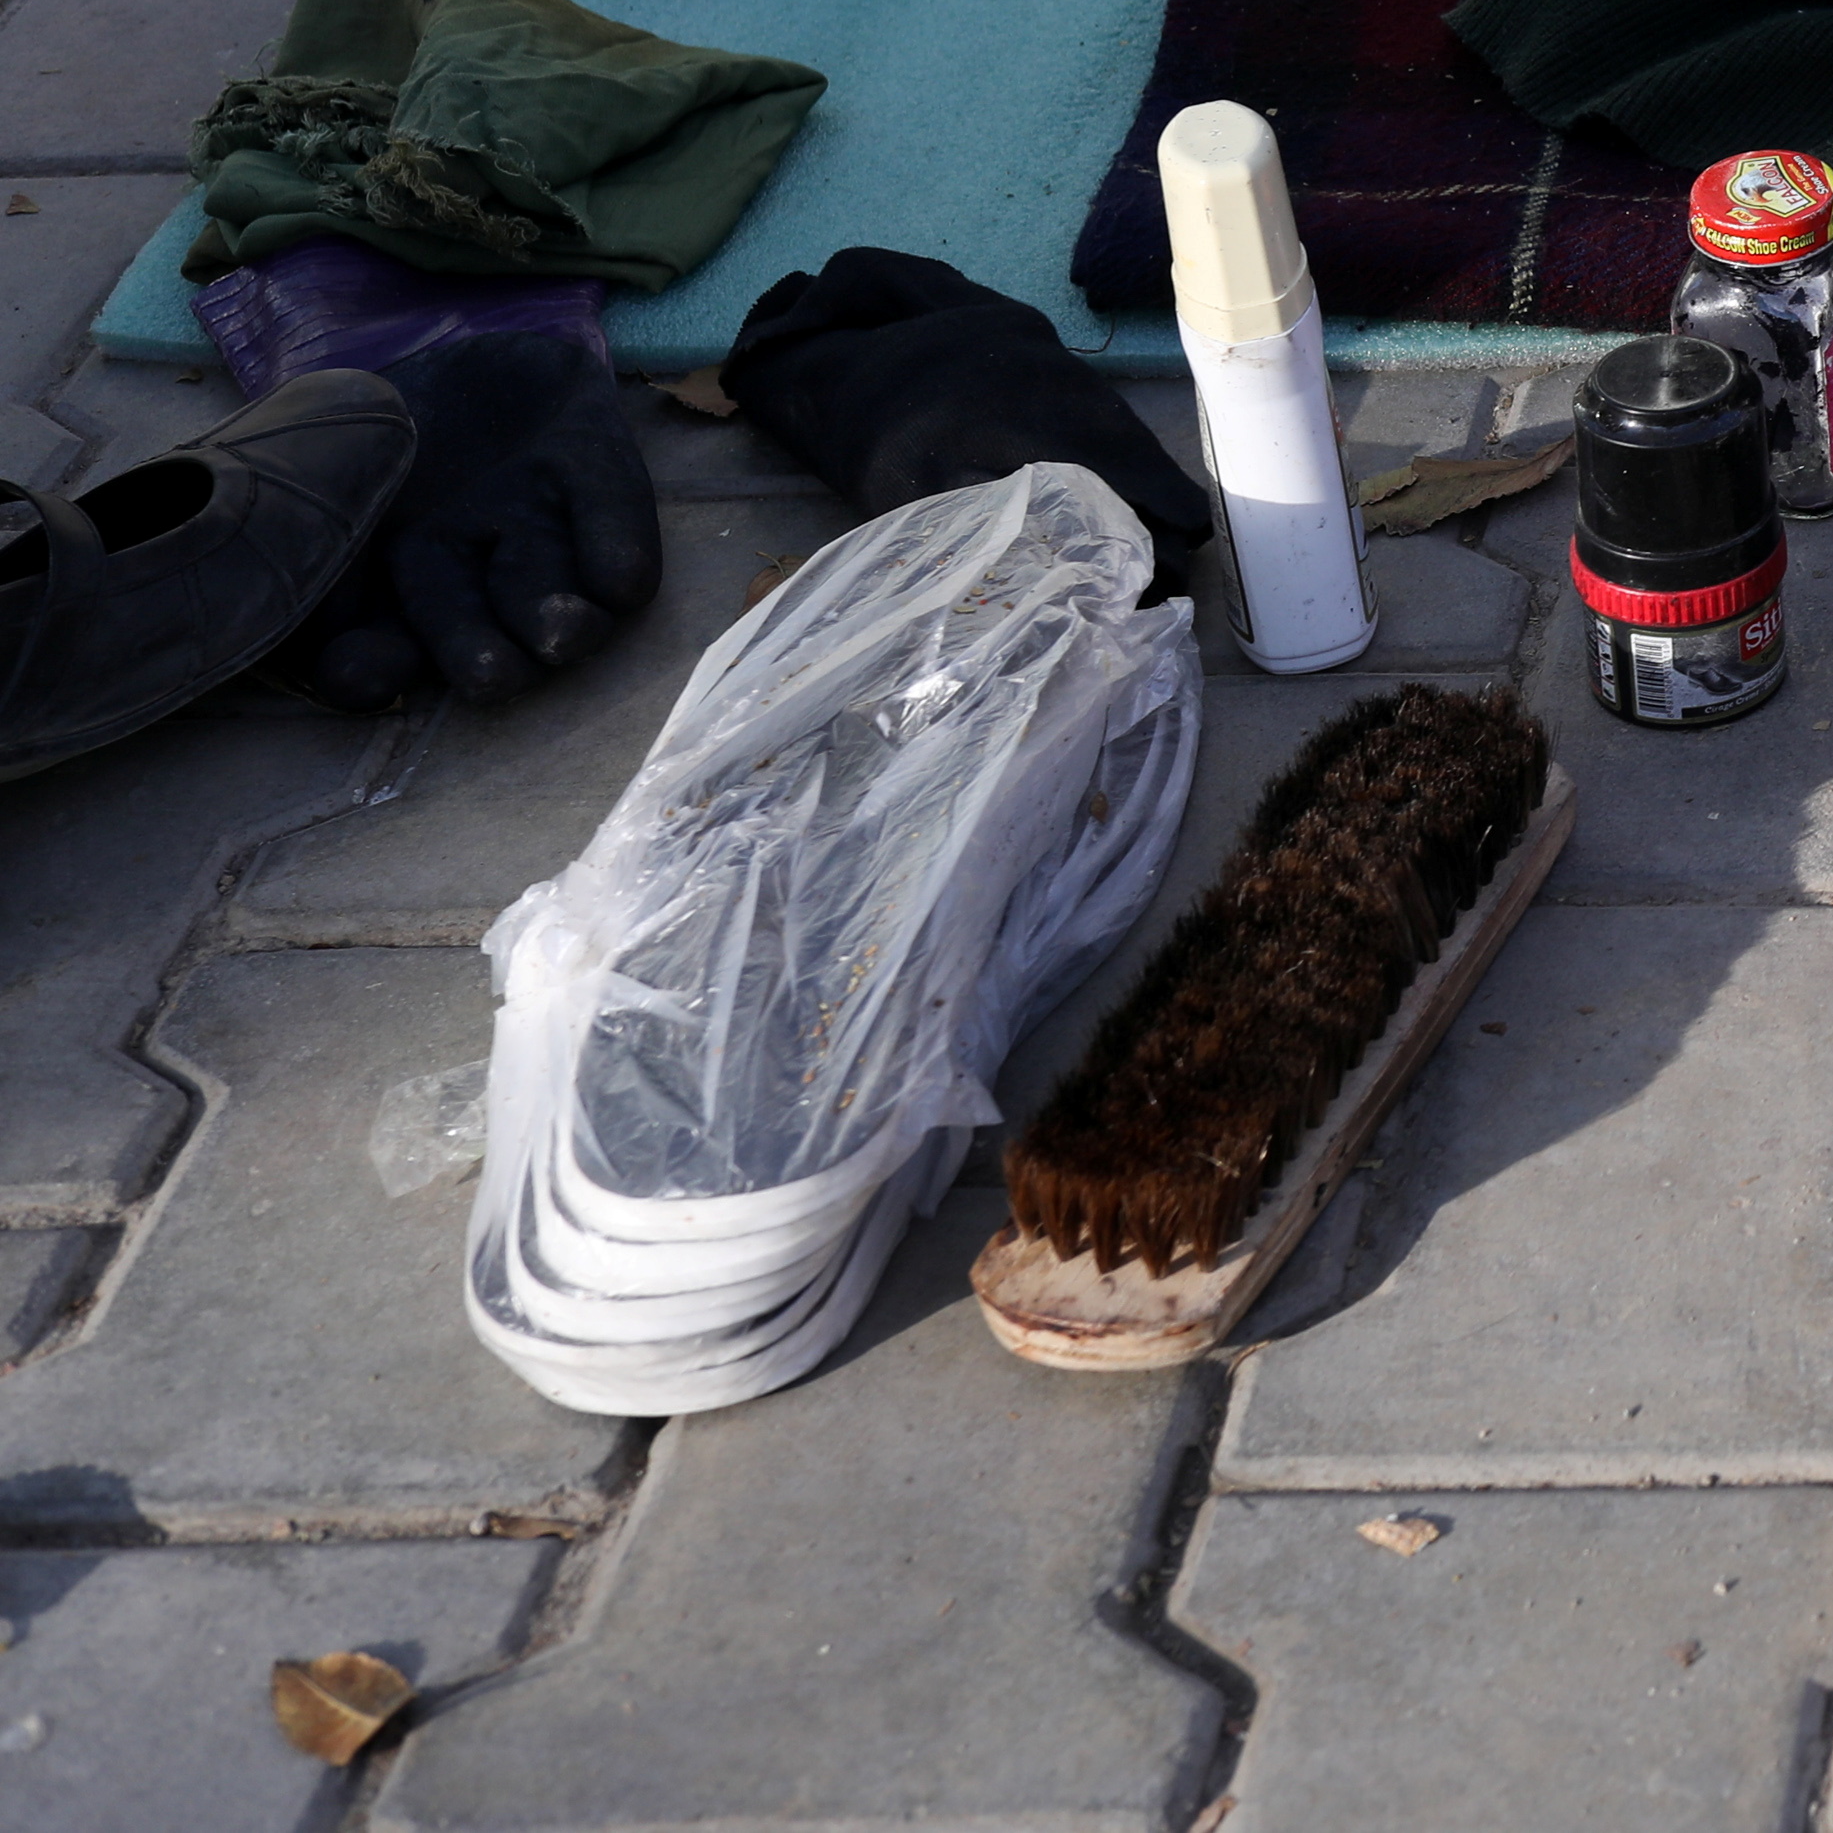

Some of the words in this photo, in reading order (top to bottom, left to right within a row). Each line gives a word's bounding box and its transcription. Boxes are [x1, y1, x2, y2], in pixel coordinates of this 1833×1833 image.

[1793, 155, 1815, 176] Cream
[1759, 159, 1804, 206] FALCON
[1811, 176, 1829, 195] Shoe
[1706, 229, 1746, 254] FALCON
[1746, 238, 1777, 255] Shoe
[1780, 231, 1815, 253] Cream
